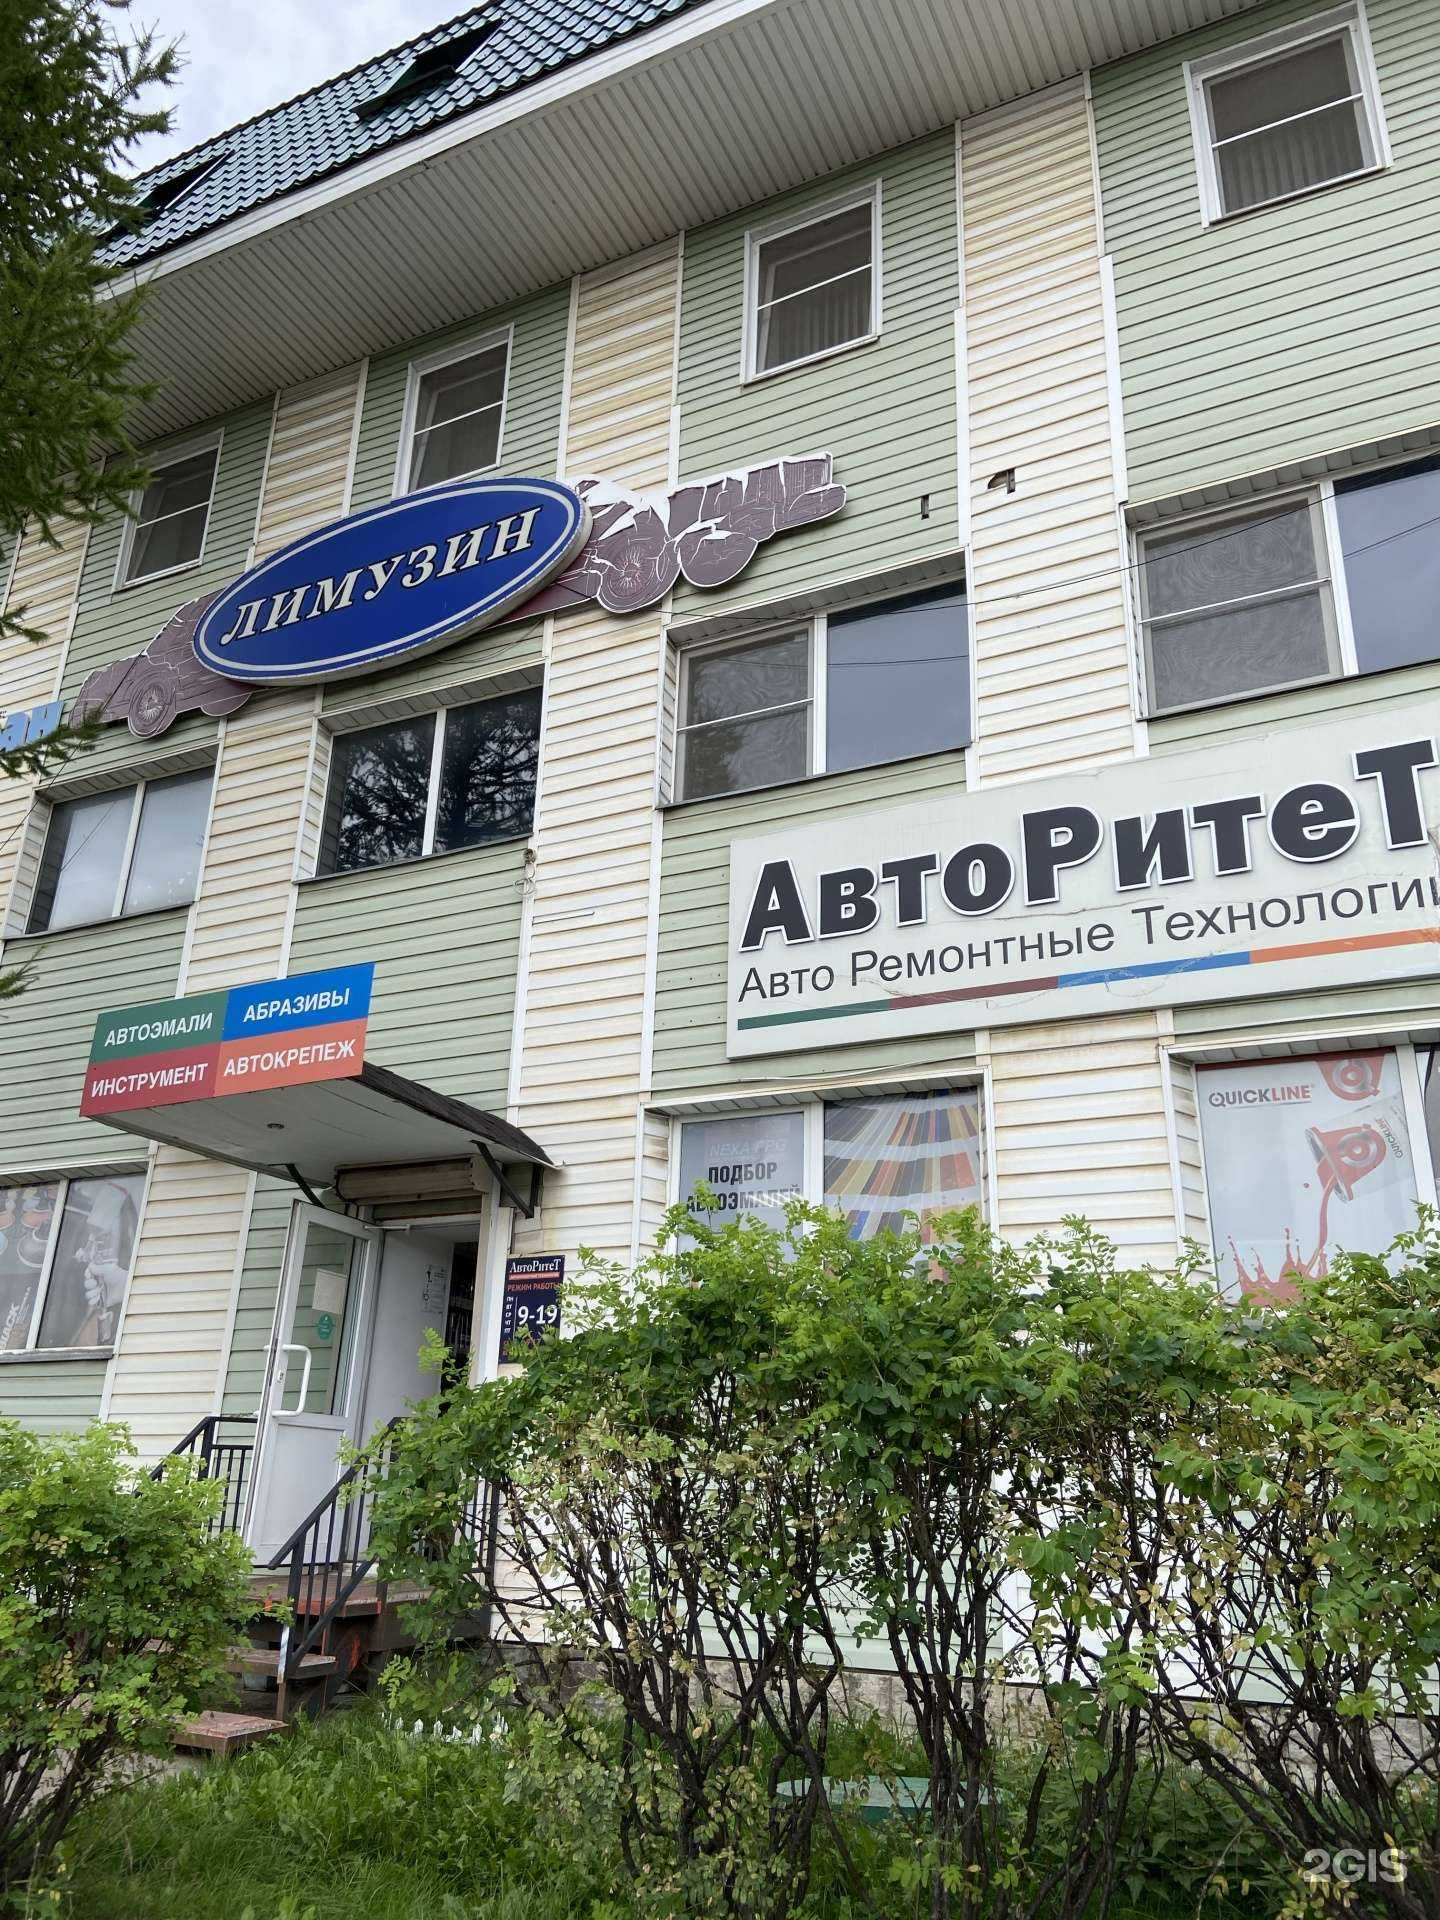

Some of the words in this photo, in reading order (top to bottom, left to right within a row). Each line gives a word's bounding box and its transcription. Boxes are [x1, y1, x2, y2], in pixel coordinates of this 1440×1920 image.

[220, 505, 543, 645] ЛИМУЗИН
[739, 737, 1438, 951] АвтоРитеТ
[739, 964, 834, 1003] Авто
[850, 922, 1114, 987] Ремонтные
[243, 987, 350, 1023] АБРАЗИВЫ
[104, 1012, 213, 1047] АВТОЭМАЛИ
[223, 1038, 355, 1077] АВТОКРЕПЕЖ
[91, 1062, 208, 1098] ИНСТРУМЕНТ
[1208, 1084, 1312, 1108] QUICKLINE
[708, 1162, 778, 1185] ПОДБОР
[517, 1304, 558, 1325] 9-19
